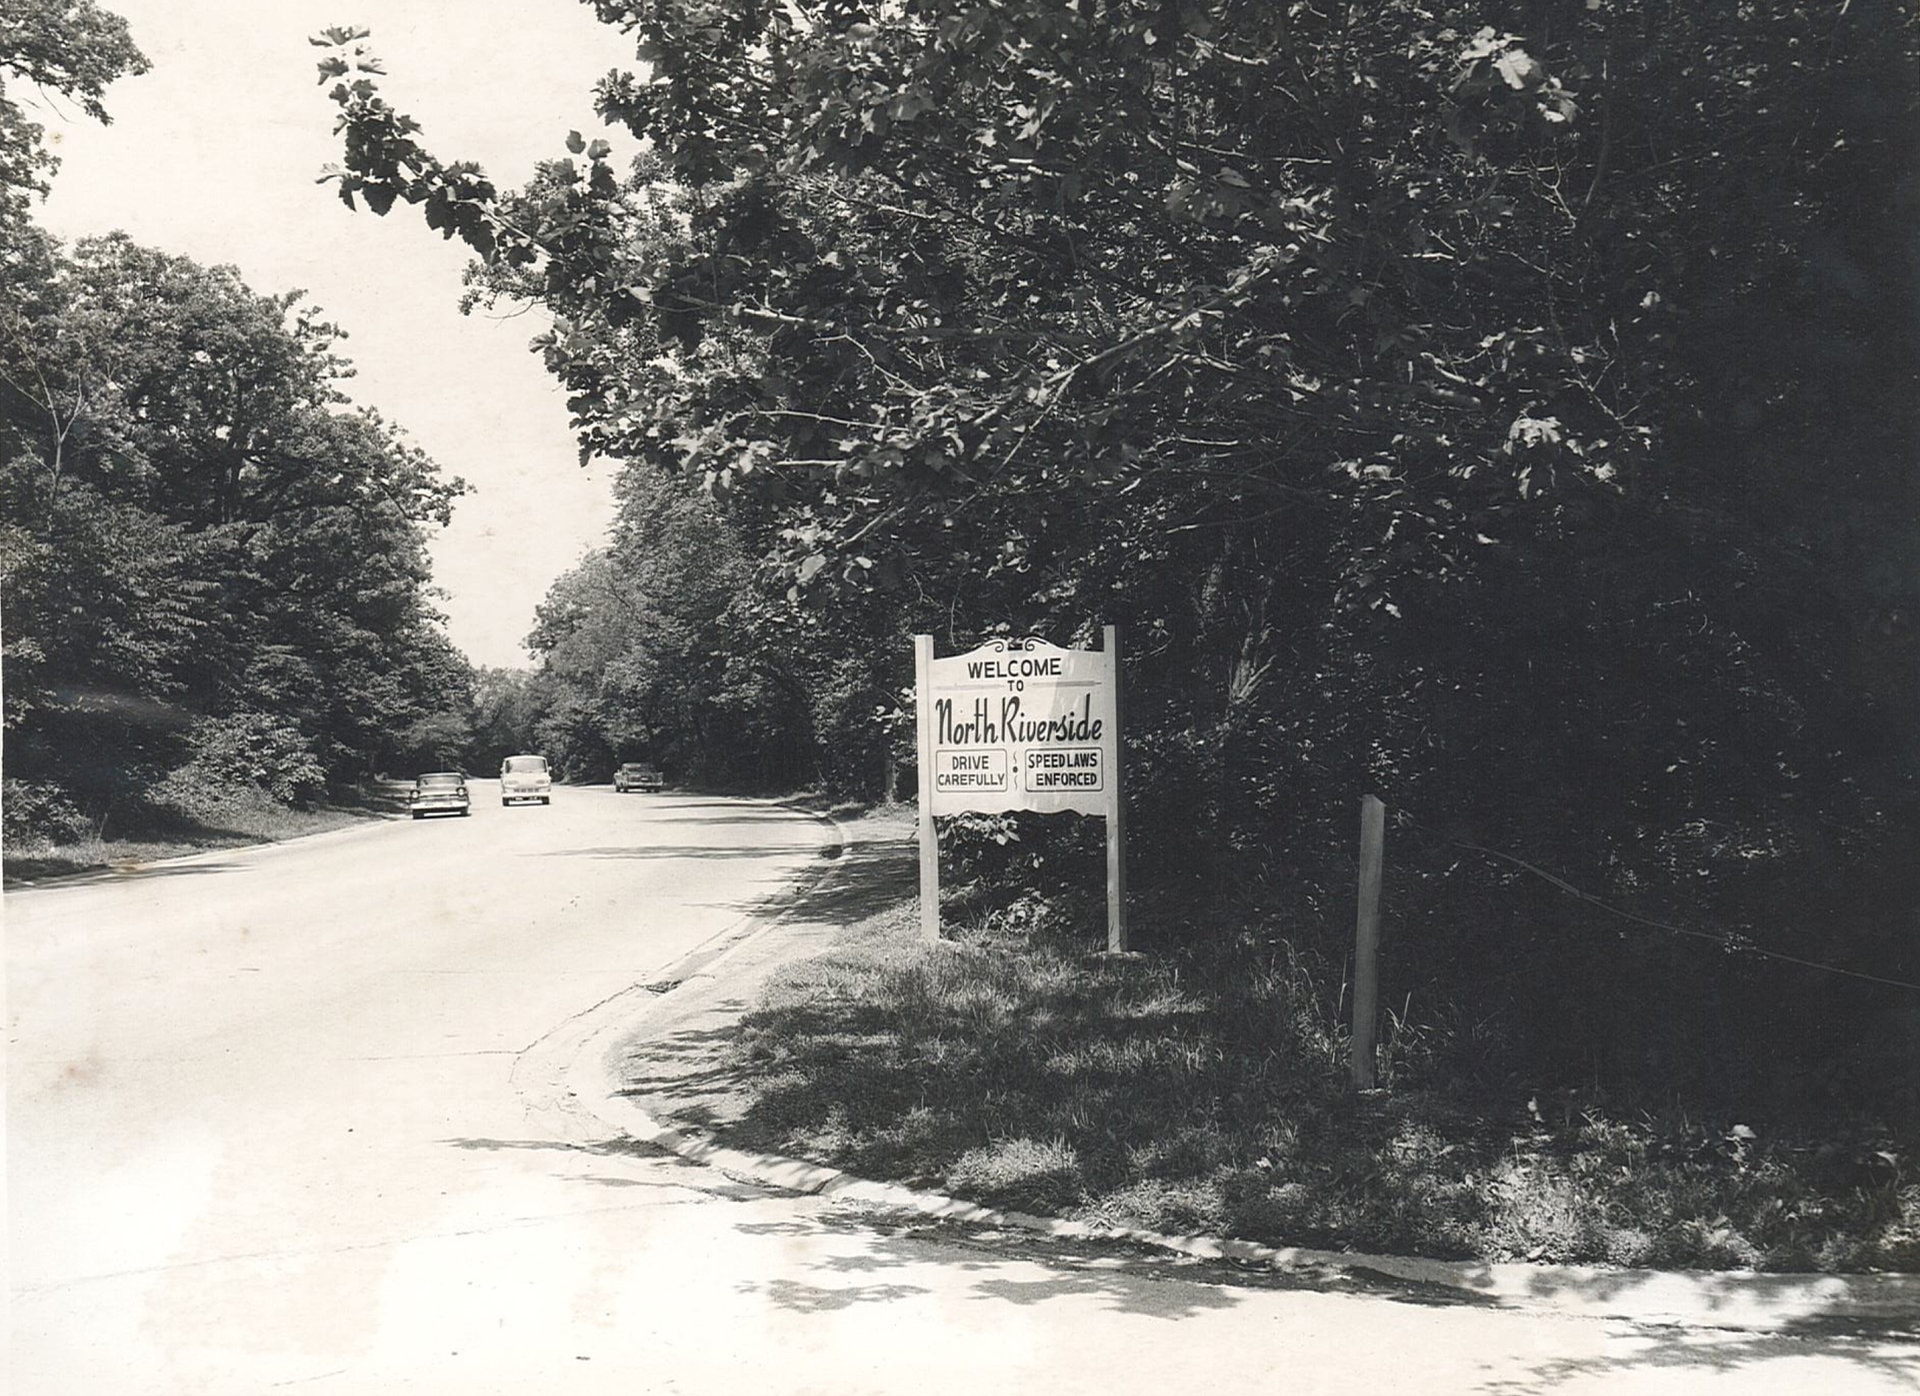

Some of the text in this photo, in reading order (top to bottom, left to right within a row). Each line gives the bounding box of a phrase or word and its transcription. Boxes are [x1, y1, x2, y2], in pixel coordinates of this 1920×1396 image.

[968, 657, 1062, 679] WELCOME
[1007, 680, 1024, 692] TO
[935, 692, 1103, 745] North Riverside
[952, 756, 989, 770] DRIVE
[1028, 753, 1098, 769] SPEED LAWS
[938, 773, 1005, 786] CAREFULLY
[1036, 772, 1097, 786] ENFORCED
